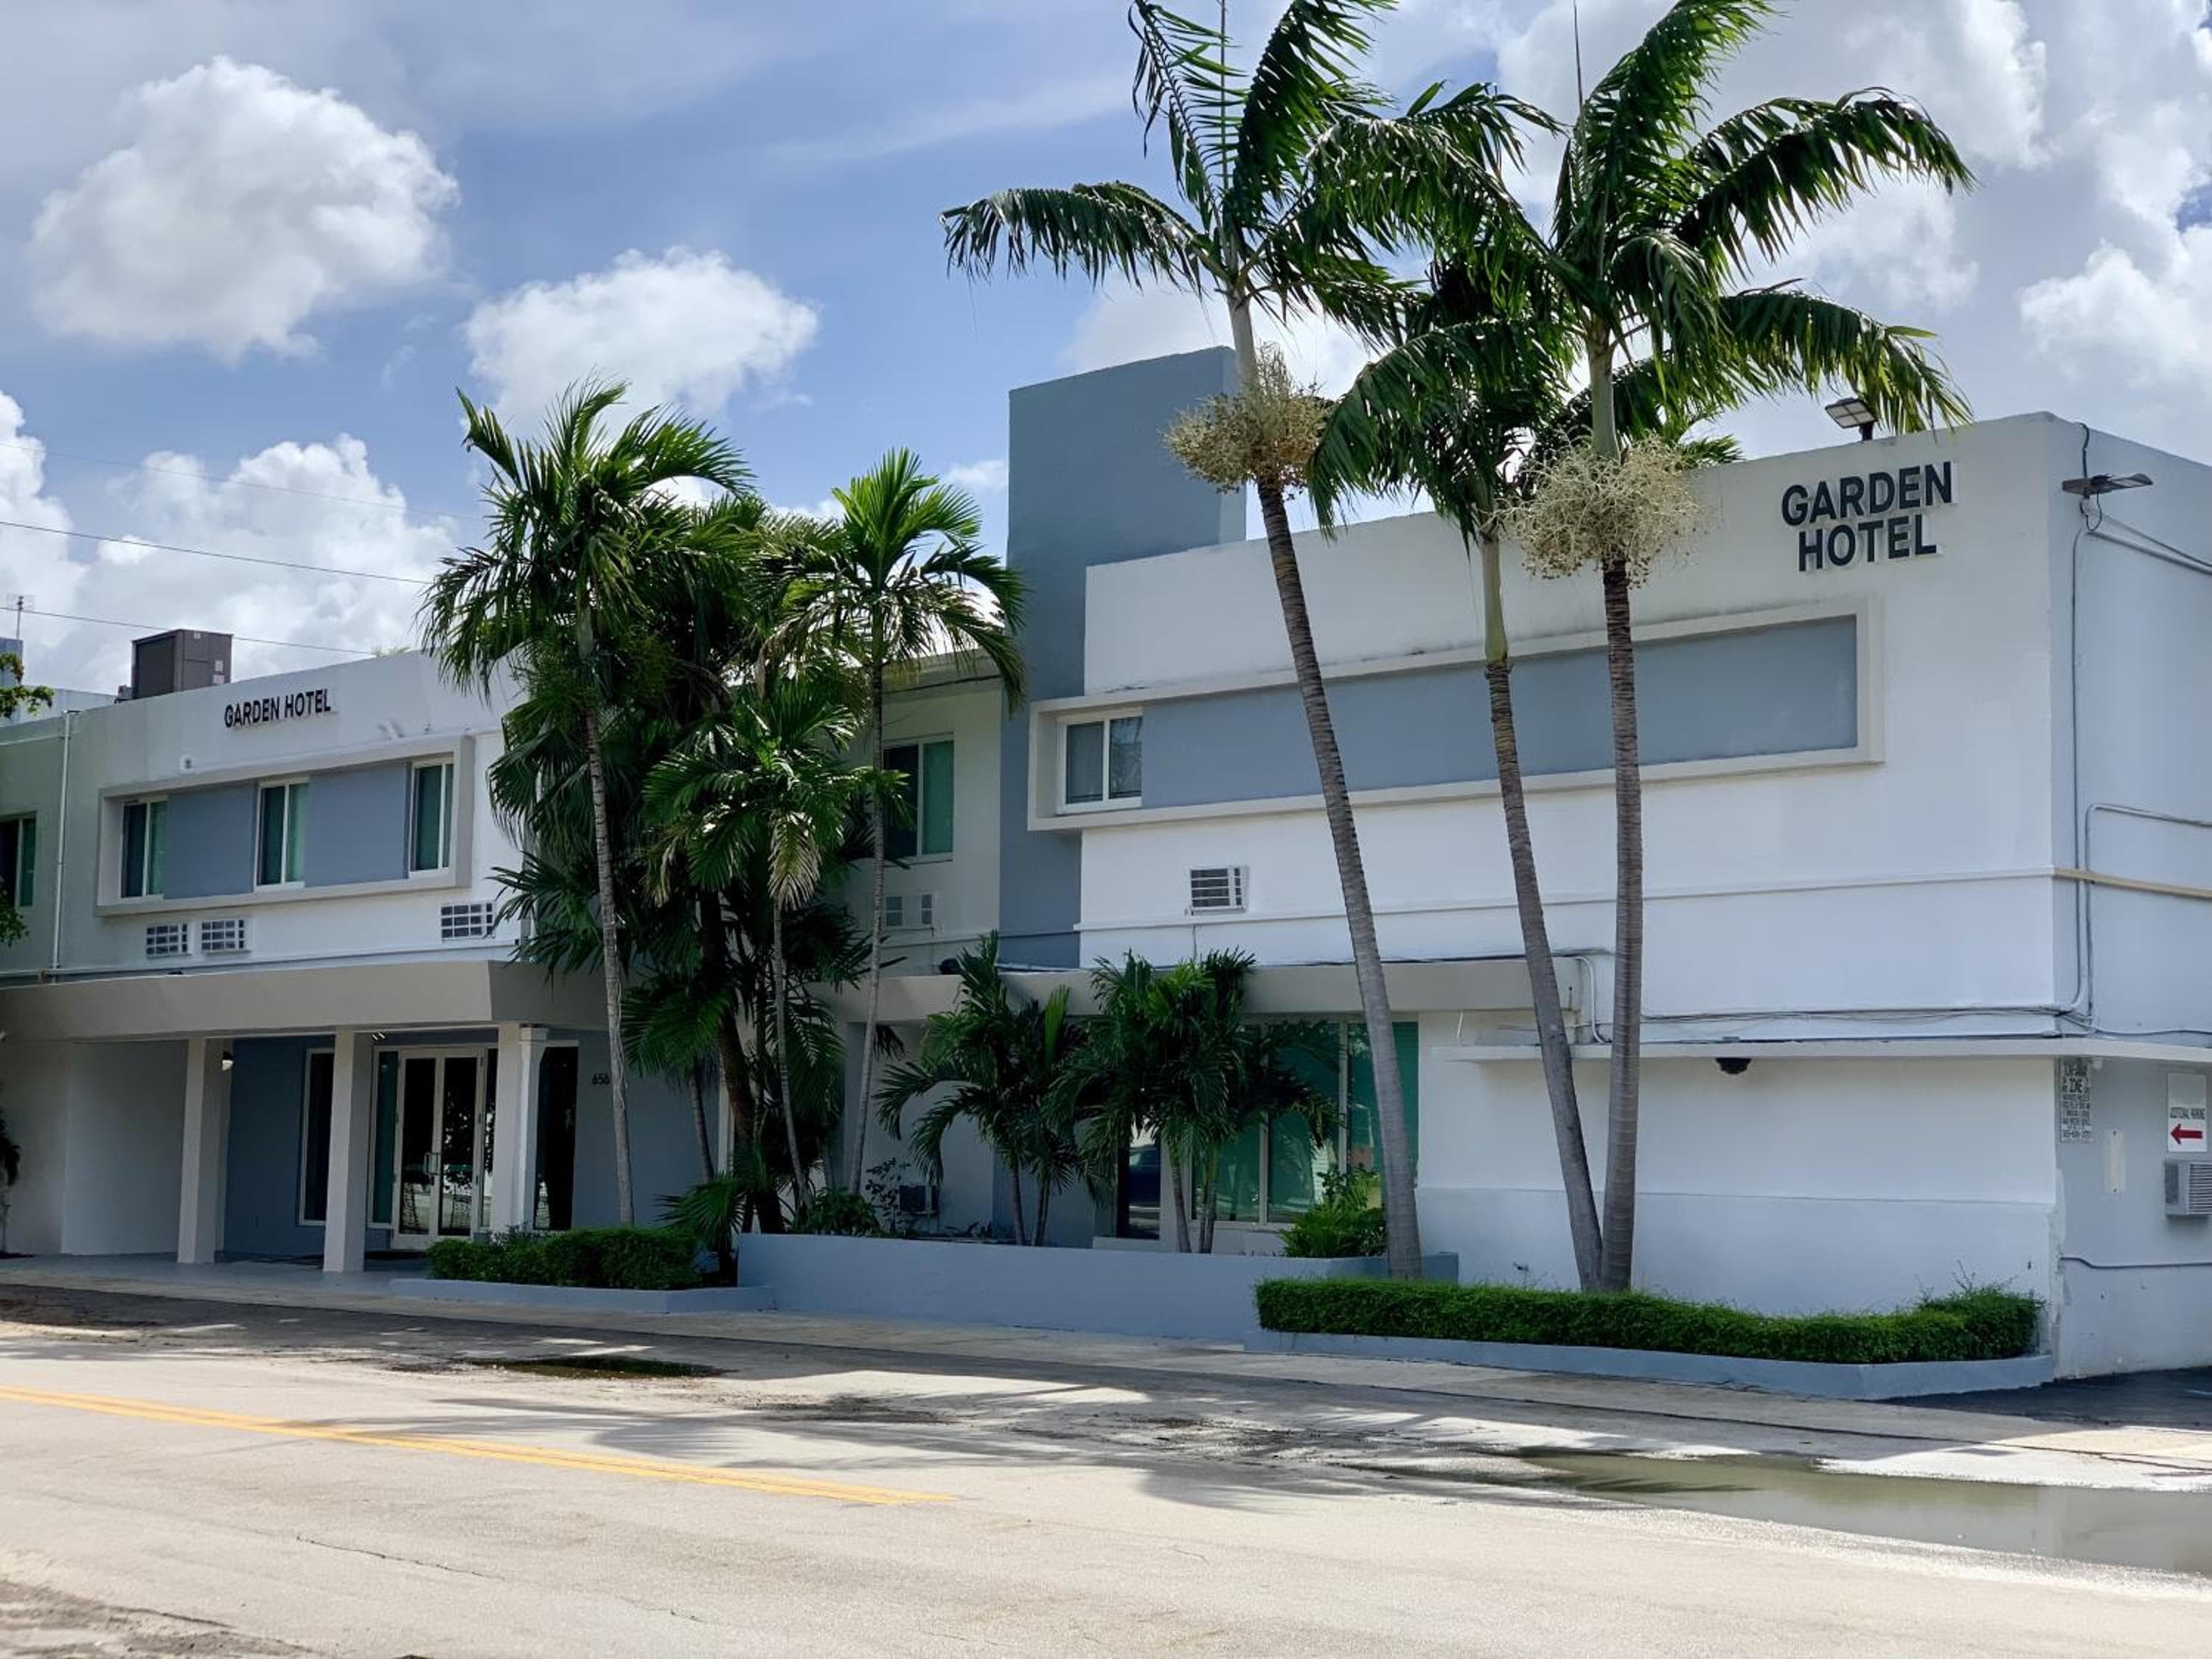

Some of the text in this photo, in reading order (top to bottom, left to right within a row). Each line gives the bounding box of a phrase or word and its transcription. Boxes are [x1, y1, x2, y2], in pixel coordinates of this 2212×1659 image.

[1781, 461, 1952, 526] GARDEN
[1798, 515, 1938, 571] HOTEL
[224, 689, 331, 728] GARDEN HOTEL
